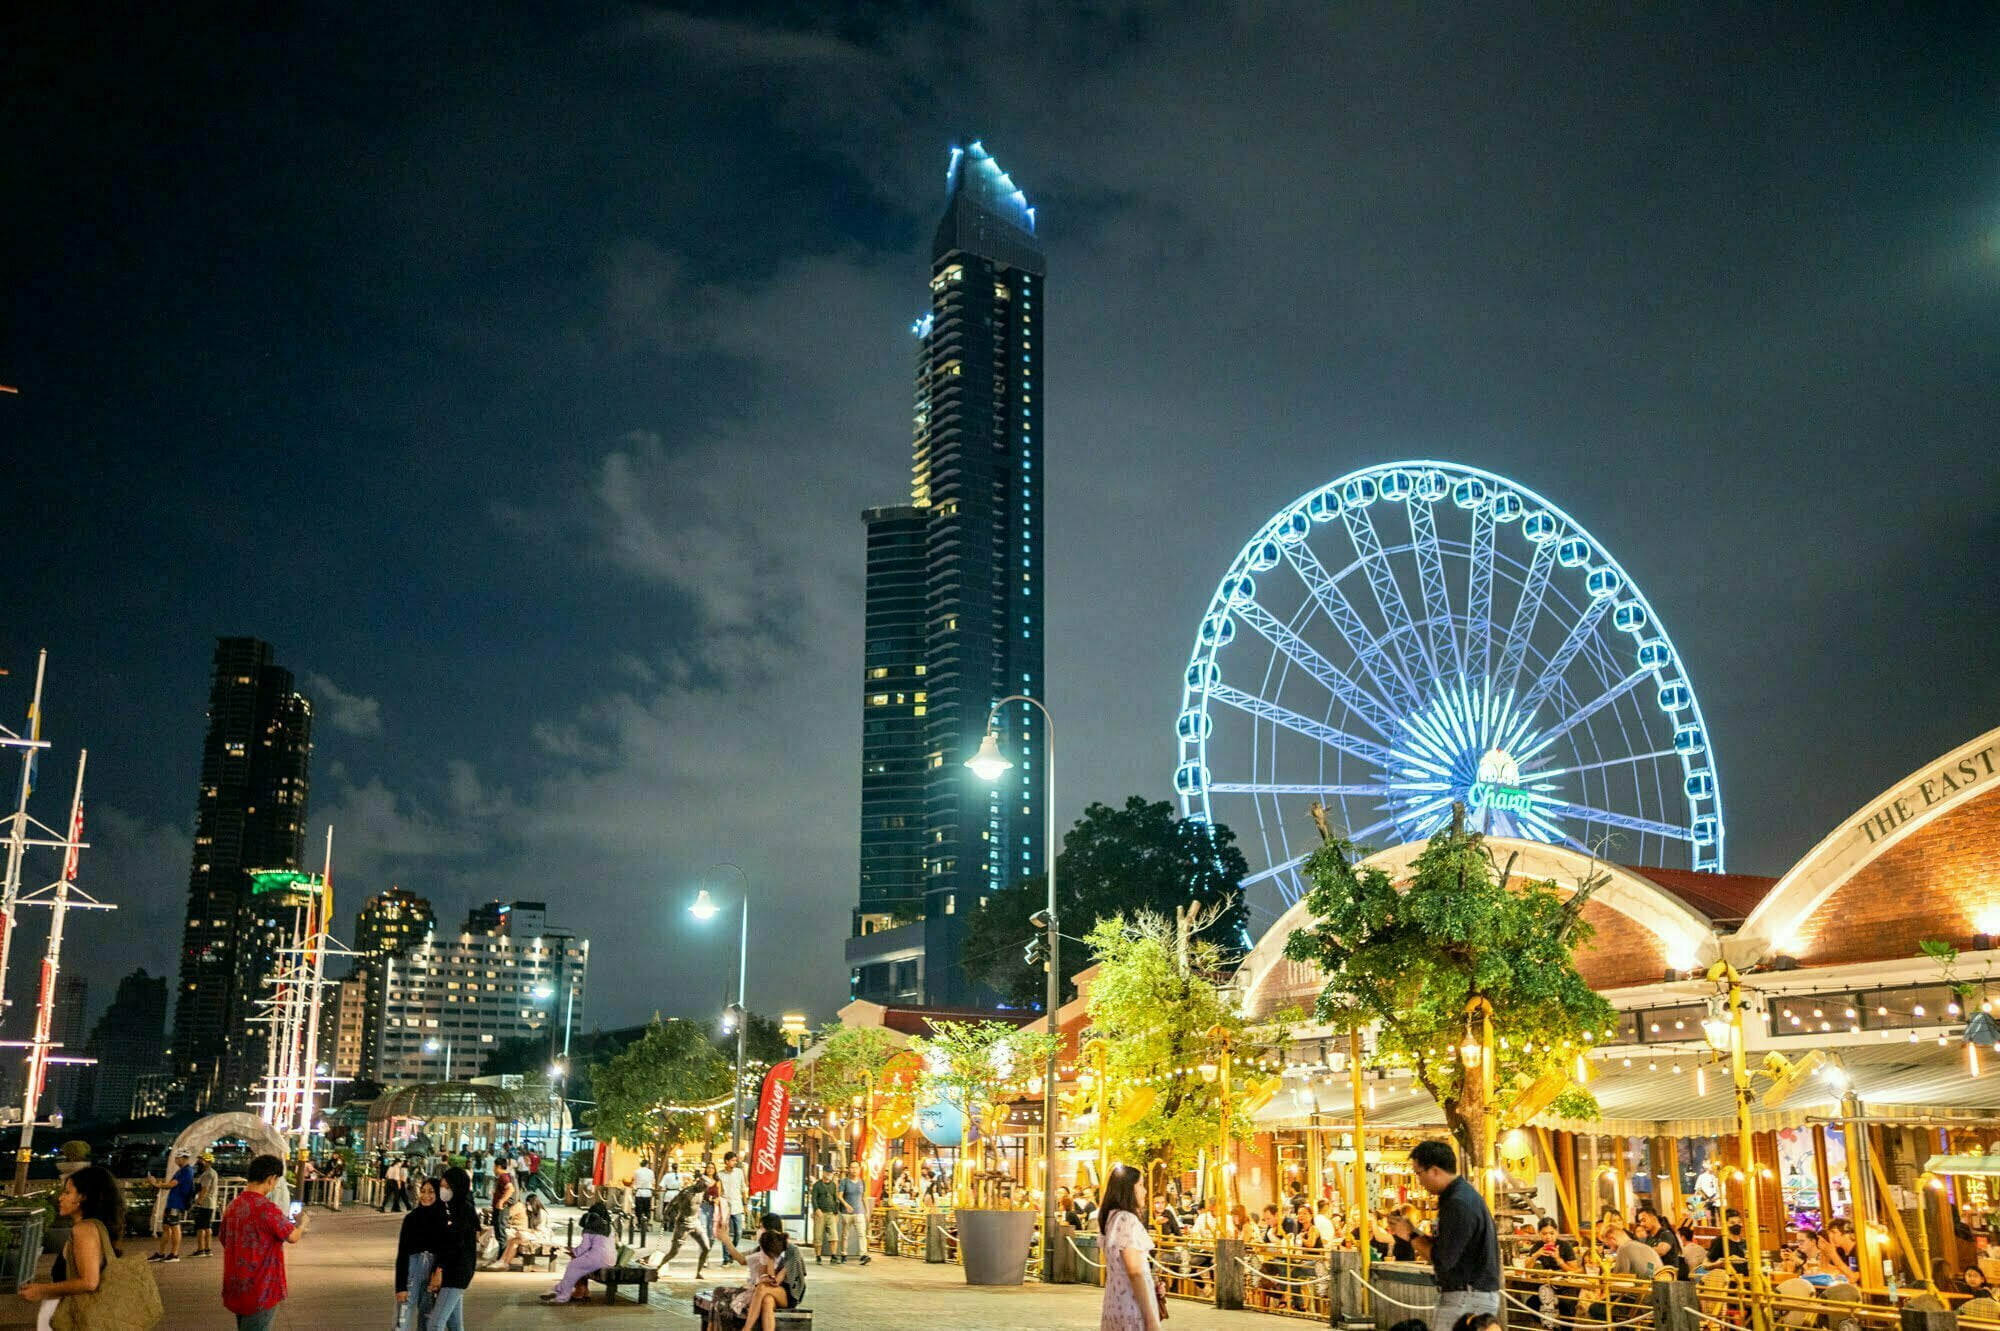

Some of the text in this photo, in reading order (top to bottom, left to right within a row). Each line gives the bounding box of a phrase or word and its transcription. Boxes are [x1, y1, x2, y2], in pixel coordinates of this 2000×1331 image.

[1468, 782, 1531, 818] Chang
[1858, 747, 1995, 844] THE EAST
[756, 1080, 785, 1175] Budweiser
